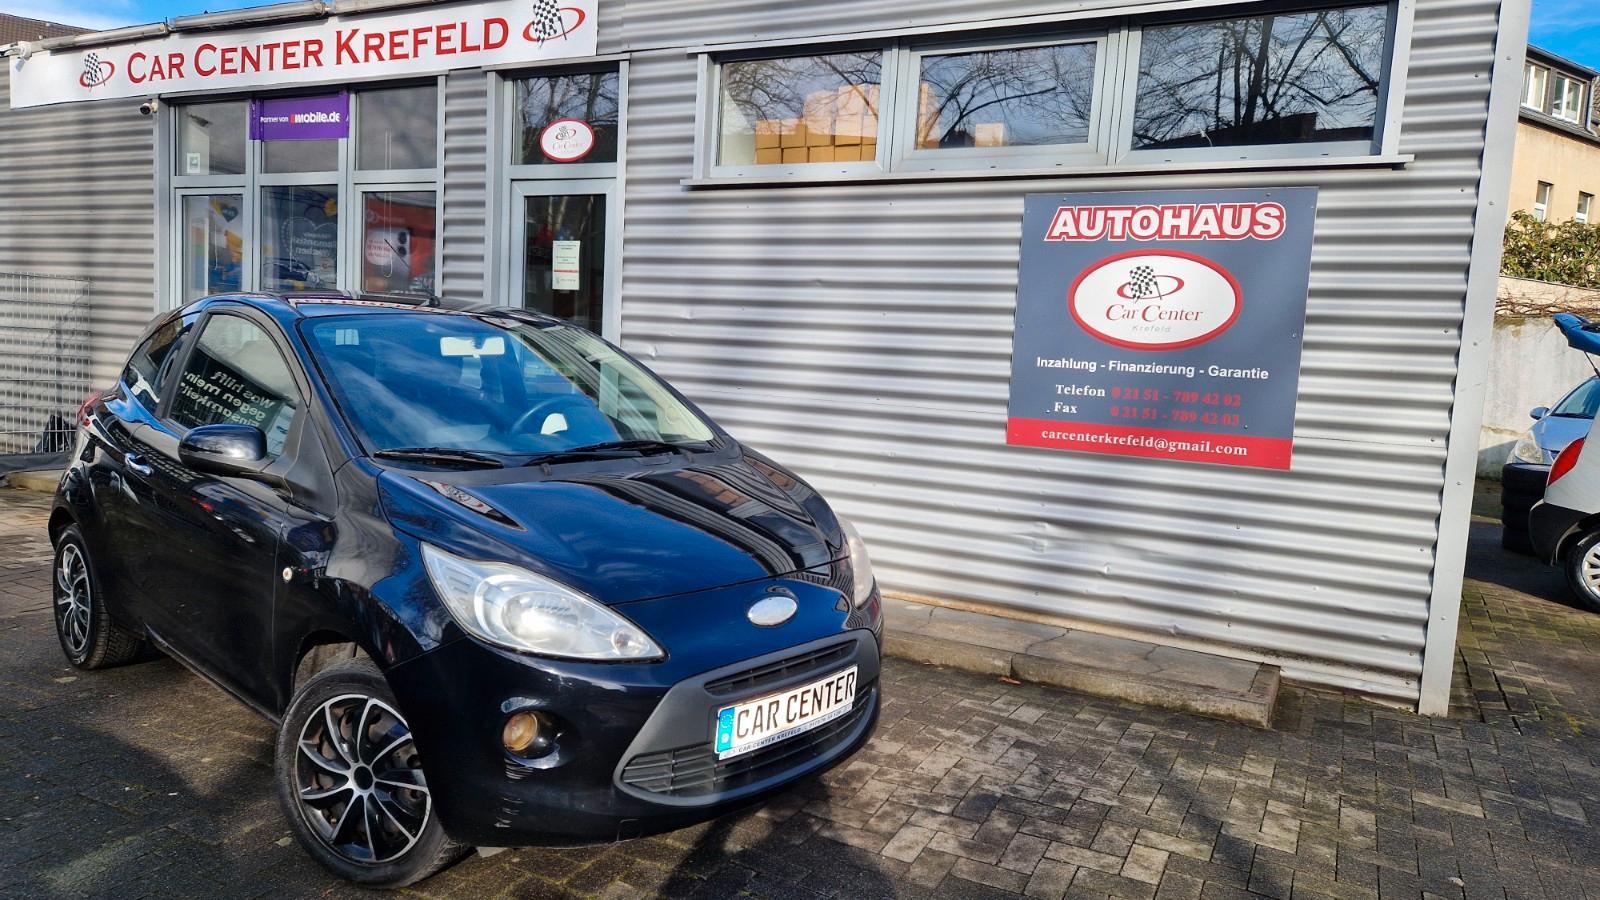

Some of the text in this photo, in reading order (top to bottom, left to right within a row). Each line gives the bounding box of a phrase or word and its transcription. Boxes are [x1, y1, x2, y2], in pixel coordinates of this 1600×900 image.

[127, 17, 510, 84] CAR CENTER KREFELD
[1044, 202, 1286, 241] AUTOHAUS
[1106, 304, 1203, 322] Car Center
[1132, 324, 1171, 333] Krefeld
[1037, 357, 1097, 373] Inzahlung
[1108, 360, 1195, 378] Finanzierung
[1208, 365, 1269, 380] Garantie
[1056, 384, 1106, 397] Telefon
[1054, 402, 1078, 414] Fax
[1041, 430, 1247, 456] carcenterkrefeld@gmail.com
[736, 700, 780, 739] CAR
[786, 671, 856, 724] CENTER
